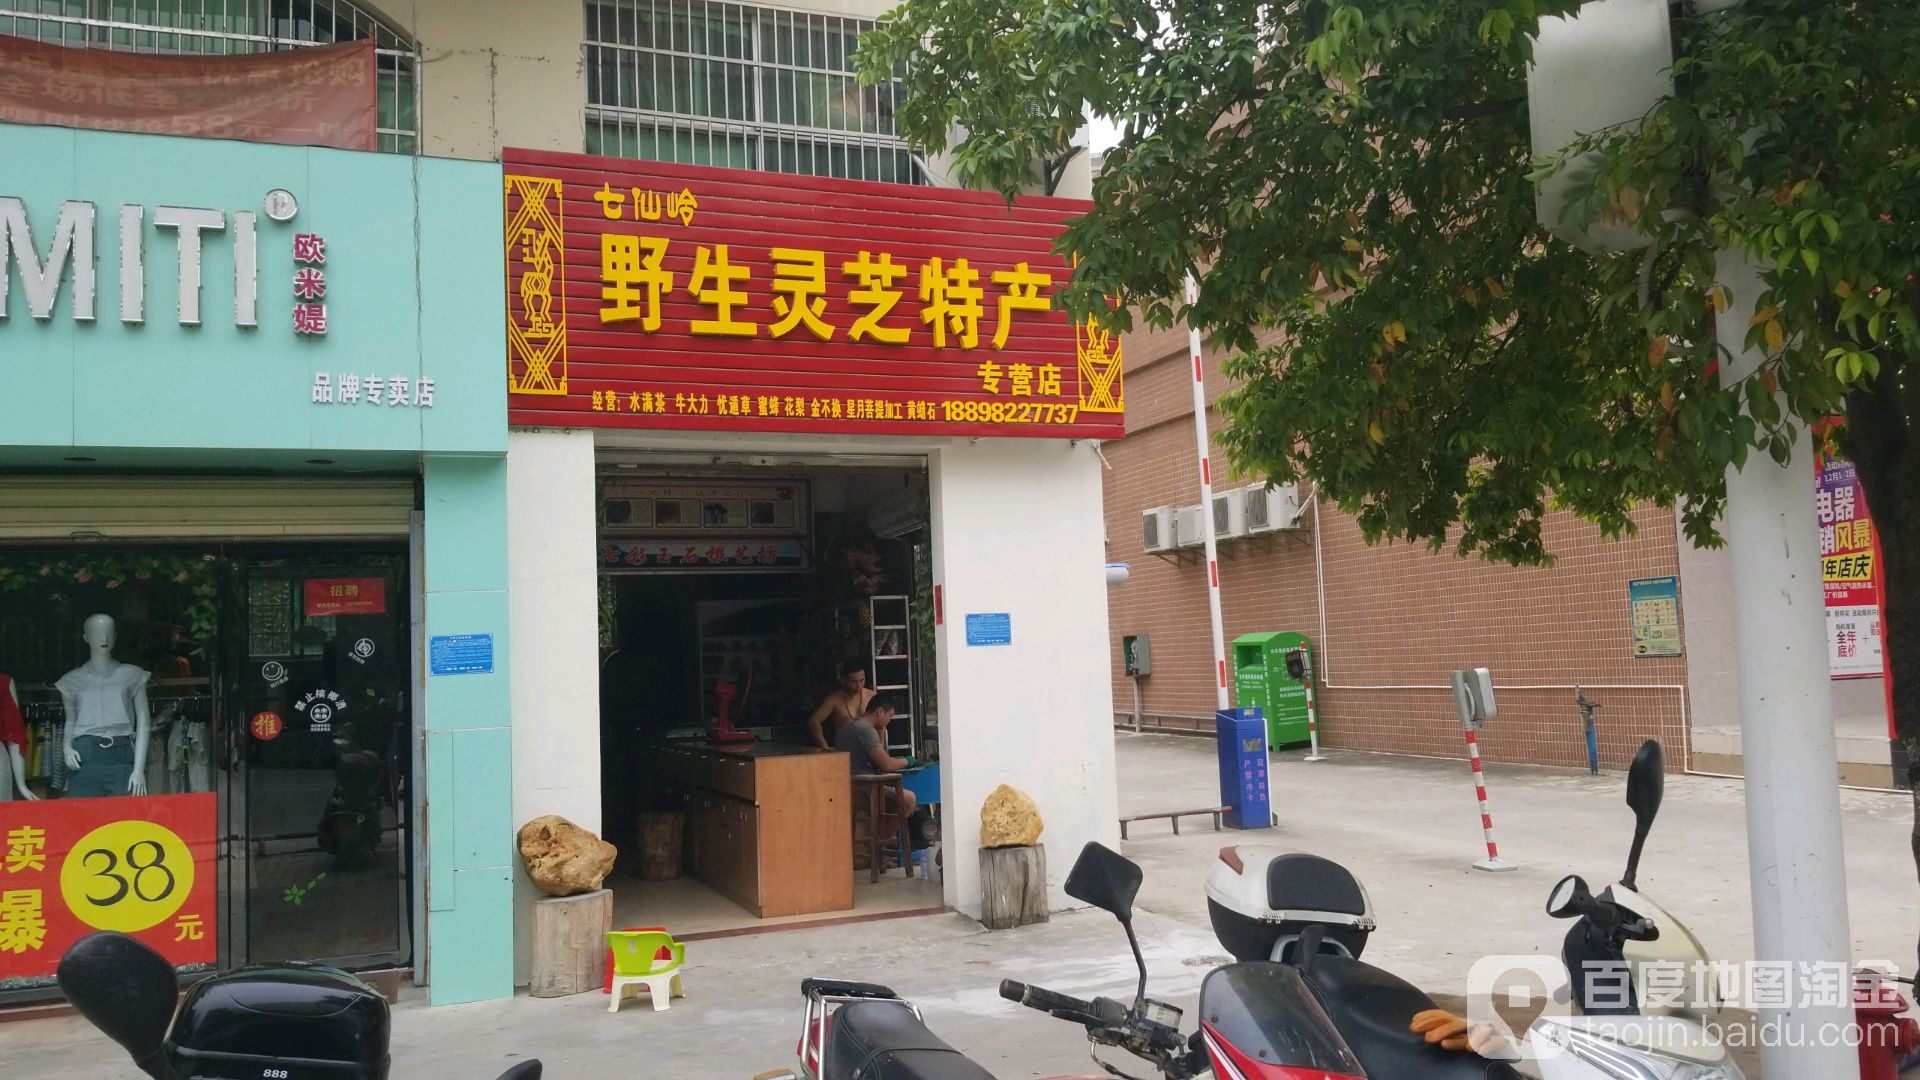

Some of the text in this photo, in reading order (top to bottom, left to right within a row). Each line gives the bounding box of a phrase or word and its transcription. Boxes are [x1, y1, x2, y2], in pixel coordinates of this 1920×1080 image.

[594, 181, 698, 227] 七仙岭
[0, 196, 257, 328] MITI
[293, 233, 327, 334] 欧米媞
[600, 233, 1051, 351] 野生灵芝特产
[312, 372, 436, 408] 品牌专卖店
[977, 360, 1061, 396] 专营店
[629, 391, 666, 413] 水满茶
[675, 393, 709, 415] 牛大力
[784, 396, 805, 418] 花梨
[810, 398, 842, 418] 金不换
[846, 399, 903, 420] 星月菩提加工
[941, 400, 1079, 424] 18898227737
[1816, 485, 1855, 523] 电器
[1821, 554, 1871, 578] 年店庆
[329, 584, 358, 597] 招聘
[254, 714, 277, 737] 推
[5, 825, 47, 874] 卖
[83, 840, 175, 907] 38
[175, 914, 204, 942] 元
[263, 1068, 288, 1079] 888
